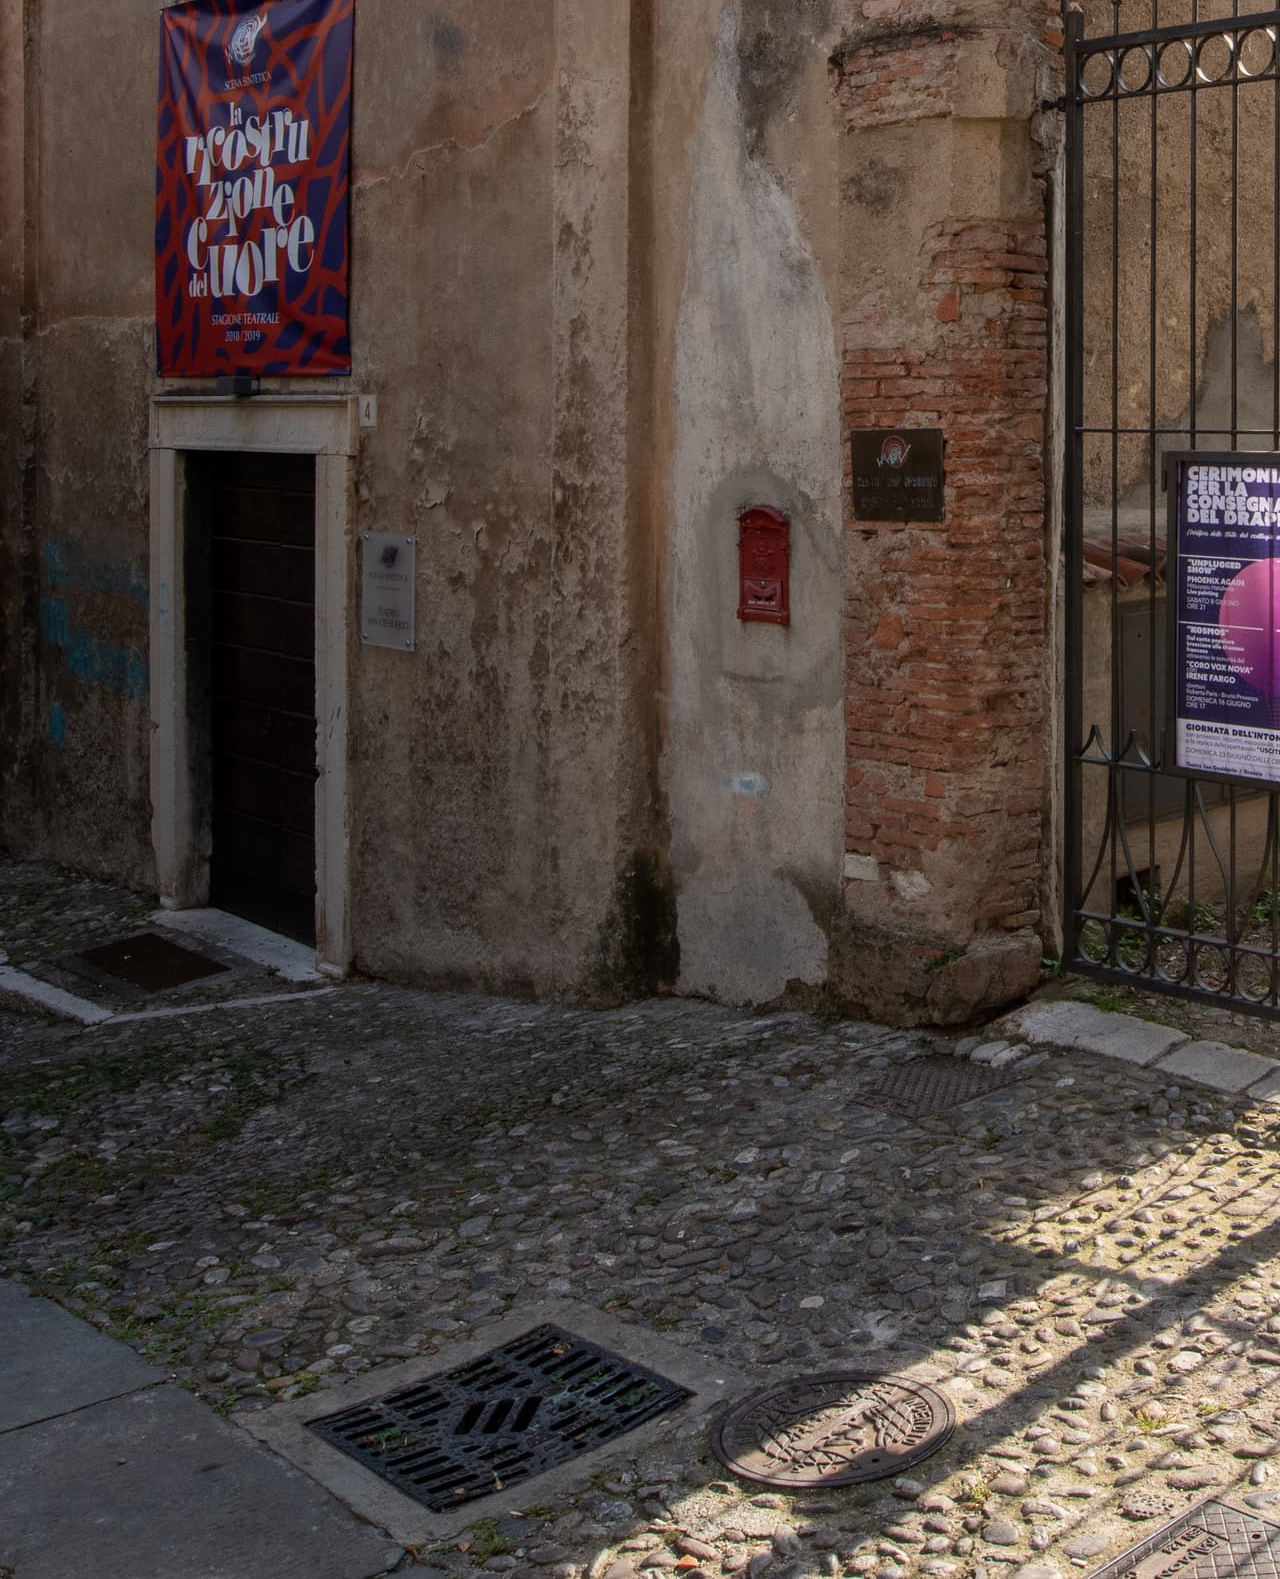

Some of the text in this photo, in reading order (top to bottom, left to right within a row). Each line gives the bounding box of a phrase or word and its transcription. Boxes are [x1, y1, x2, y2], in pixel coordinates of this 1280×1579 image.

[242, 71, 272, 86] SINTETICA
[229, 102, 242, 126] la
[206, 166, 296, 236] zione
[187, 215, 315, 298] del cuore
[211, 312, 280, 326] STAGIONE TEATRALE
[1187, 480, 1248, 497] PER LA
[1187, 508, 1219, 524] DEL
[1187, 558, 1242, 569] "UNPLUGGED
[1187, 566, 1216, 575] SHOW"
[1187, 575, 1245, 587] PHOENIX AGAIN
[1187, 596, 1209, 604] SABATO
[1186, 625, 1230, 637] "KOSMOS"
[1186, 660, 1254, 675] "CORO VOX NOVA"
[1186, 672, 1236, 684] IRENE FARGO
[1186, 695, 1218, 705] DOMENICA
[1226, 700, 1251, 709] GIUGNO
[1186, 701, 1198, 709] ORE
[1185, 723, 1230, 736] GIORNATA
[1185, 747, 1217, 757] DOMENICA
[1226, 752, 1251, 761] GIUGNO
